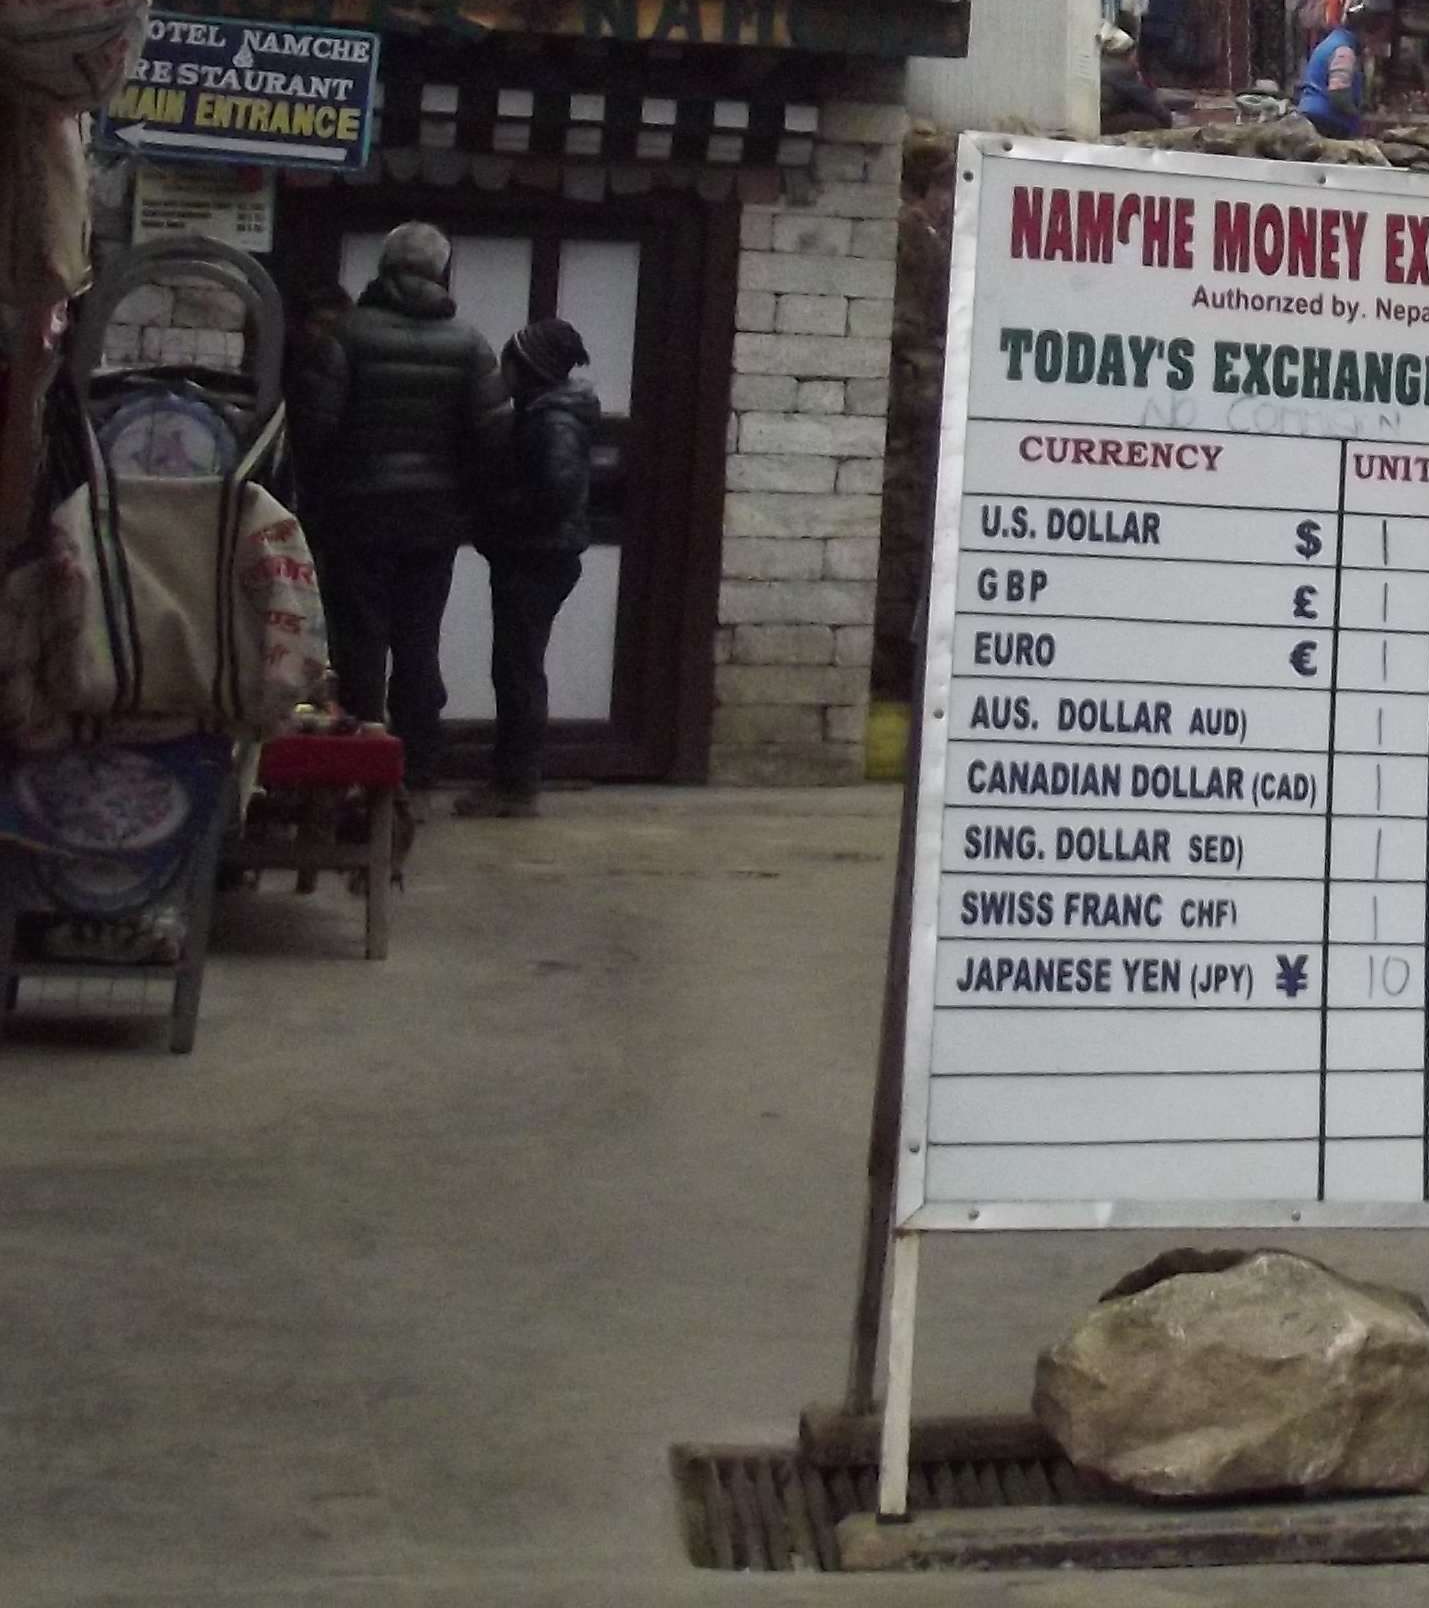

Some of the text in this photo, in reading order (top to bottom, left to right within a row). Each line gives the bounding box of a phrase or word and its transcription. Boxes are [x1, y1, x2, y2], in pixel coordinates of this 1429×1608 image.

[243, 29, 371, 64] NAMCHE
[128, 58, 354, 102] RESTAURANT
[109, 85, 362, 142] MAIN ENTRANCE
[1211, 199, 1369, 283] MONEY
[1191, 284, 1323, 316] Authorized
[1331, 289, 1367, 323] by.
[999, 327, 1195, 392] TODAY'S
[1018, 435, 1225, 473] CURRENCY
[981, 505, 1323, 560] U.S. DOLLAR $
[1291, 584, 1319, 622] £
[973, 632, 1319, 678] EURO €
[969, 694, 1039, 731] AUS.
[1057, 697, 1173, 735] DOLLAR
[966, 758, 1318, 809] CANADIAN DOLLAR (CAD)
[963, 824, 1046, 861] SING.
[1055, 826, 1172, 863] DOLLAR
[960, 889, 1054, 927] SWISS
[1063, 892, 1164, 928] FRANC
[956, 953, 1310, 1001] JAPANESE YEN (JPY) ¥
[1367, 954, 1411, 999] 10
